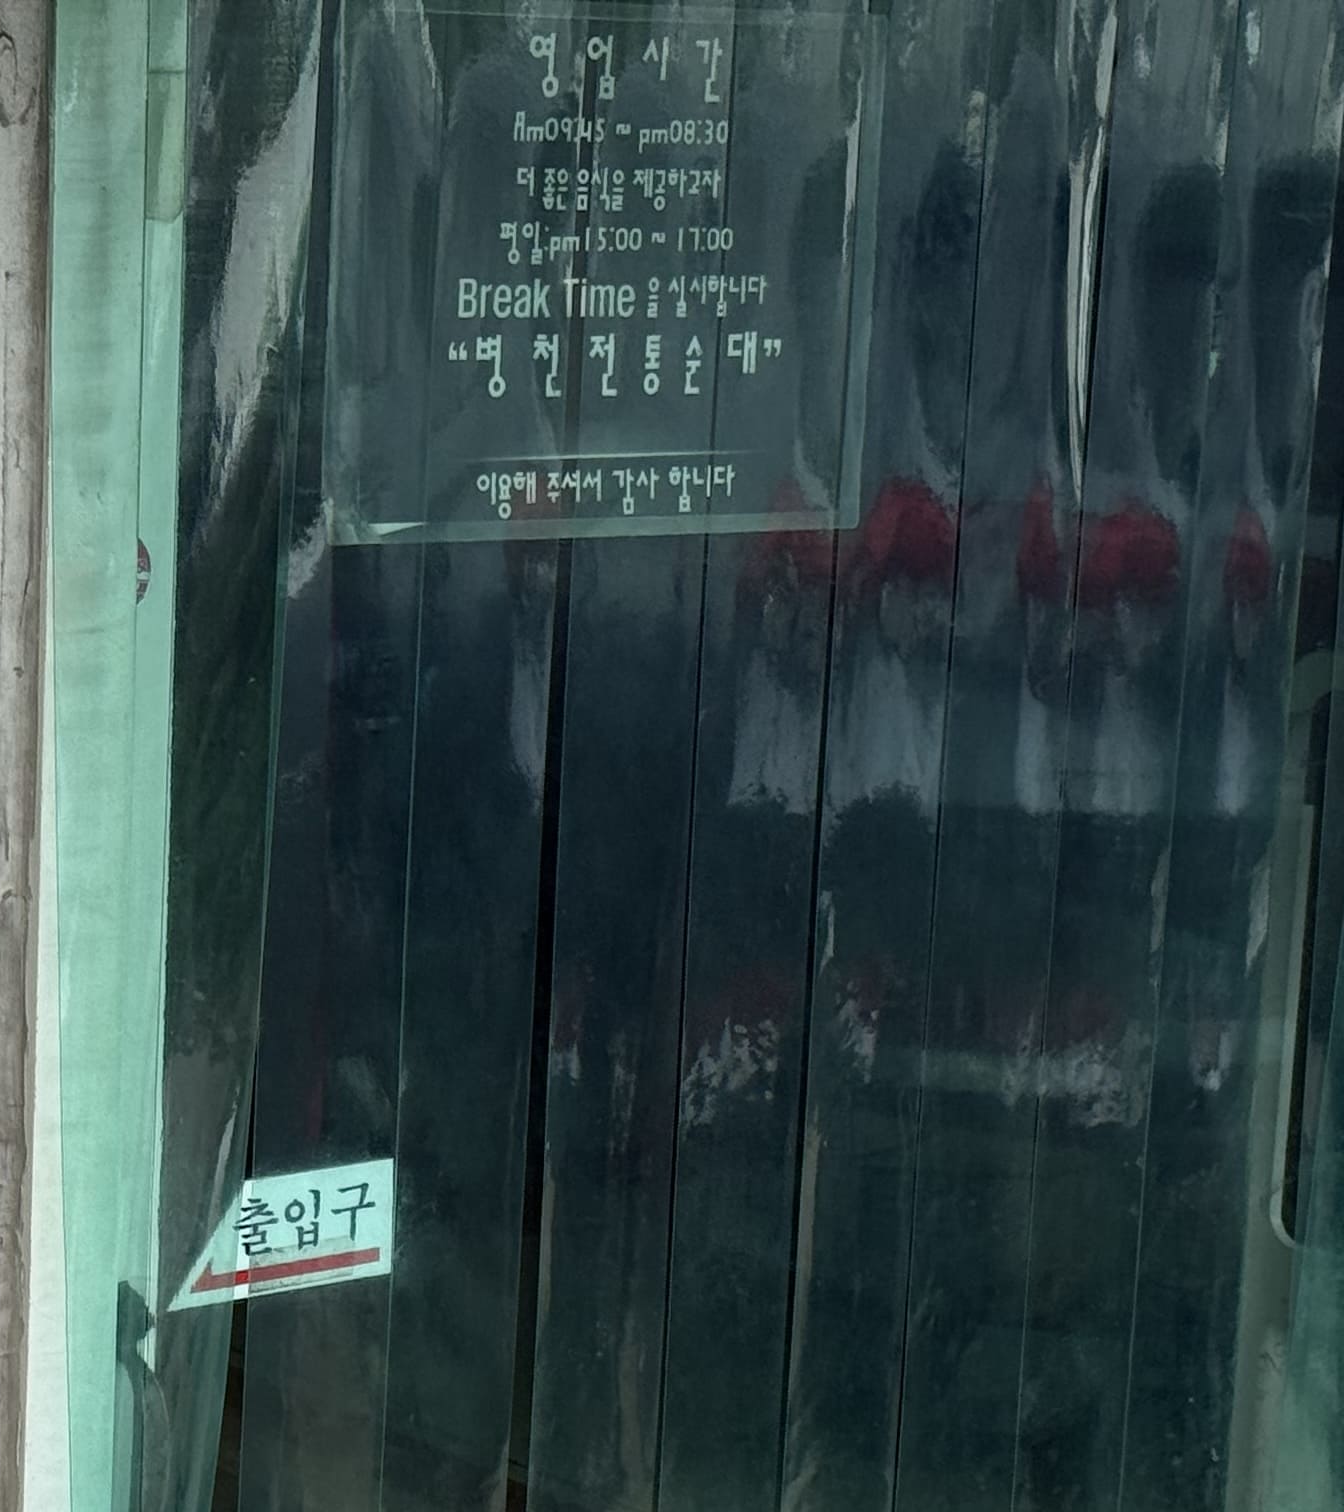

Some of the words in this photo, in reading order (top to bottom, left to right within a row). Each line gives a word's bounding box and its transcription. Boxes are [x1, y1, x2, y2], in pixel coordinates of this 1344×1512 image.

[639, 119, 729, 154] pm08:30
[517, 166, 535, 197] 더
[542, 167, 568, 211] 좋은
[576, 167, 624, 211] 음식을
[632, 167, 721, 211] 제공하고자
[677, 227, 734, 252] 17:00
[457, 278, 551, 319] Break
[562, 278, 636, 318] Time
[647, 276, 660, 318] 을
[668, 275, 768, 318] 실시합니다
[476, 471, 536, 519] 이용해
[547, 468, 602, 503] 주셔서
[612, 467, 659, 515] 감사
[668, 465, 736, 512] 합니다
[233, 1182, 377, 1258] 출입구
